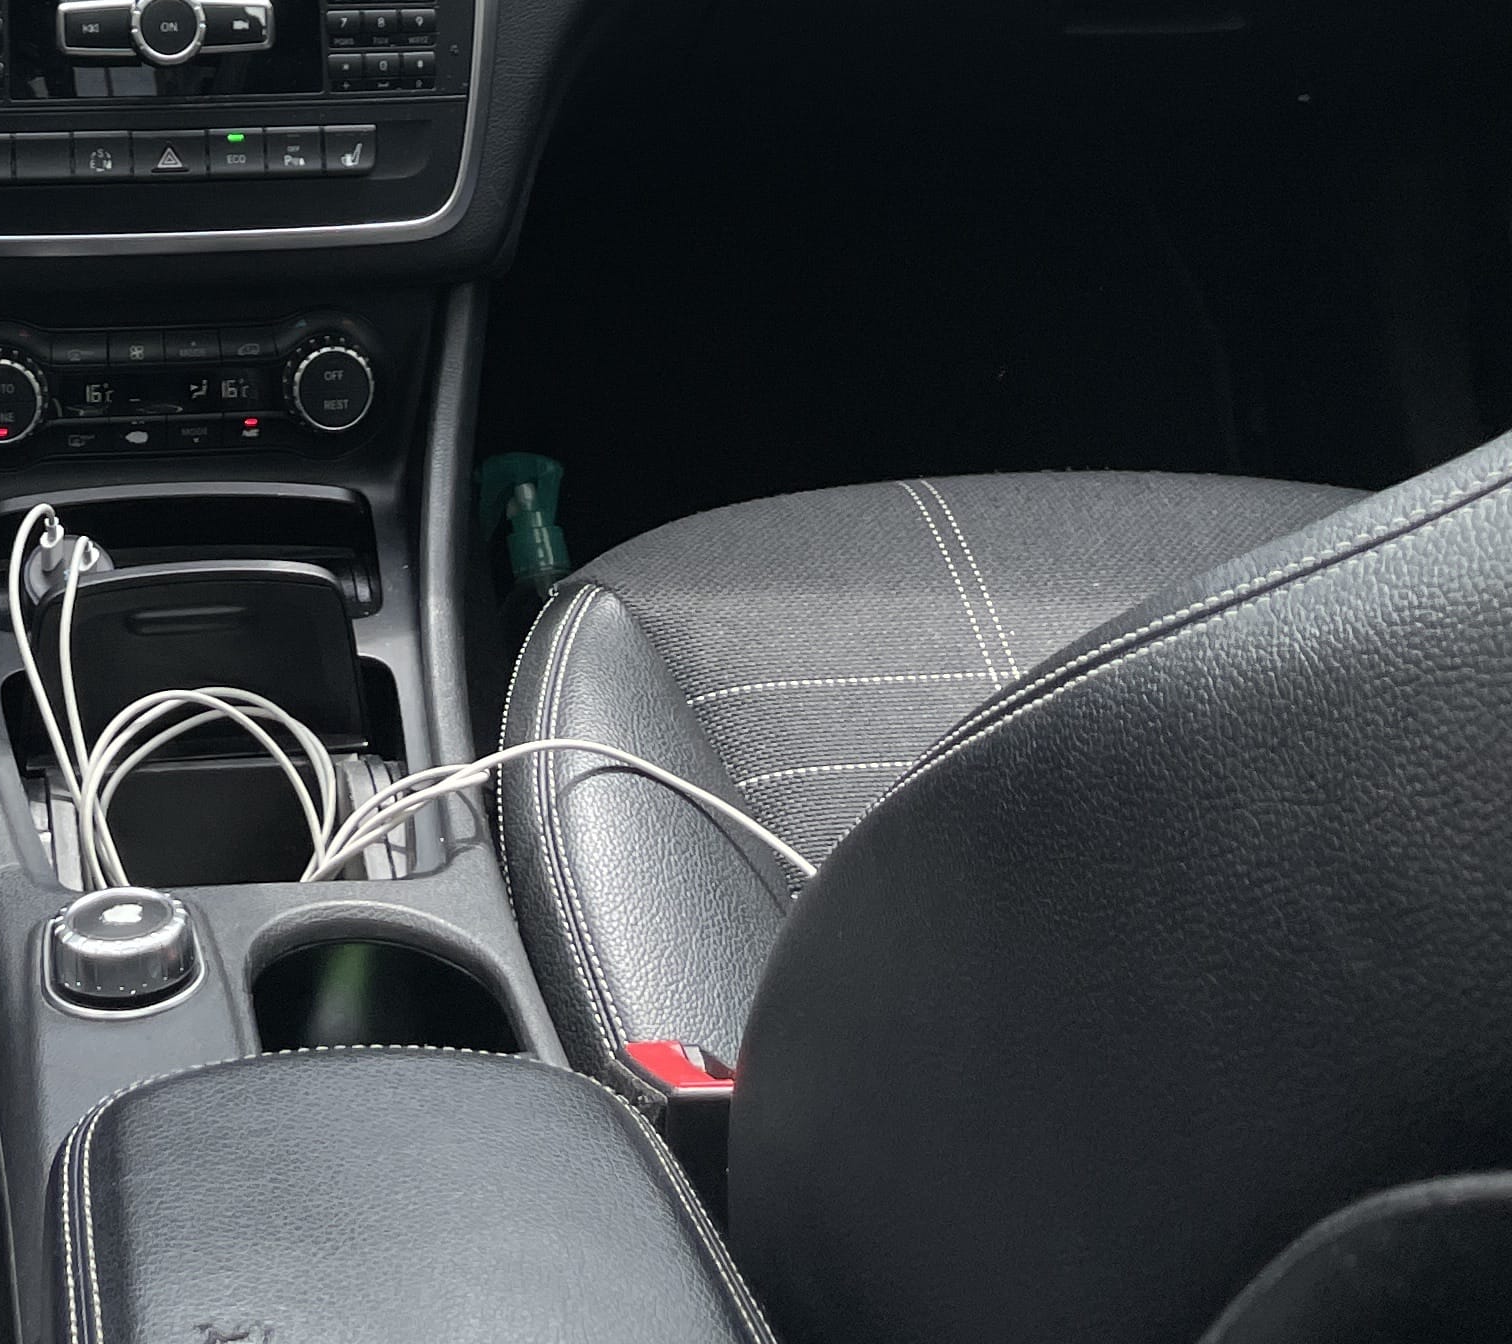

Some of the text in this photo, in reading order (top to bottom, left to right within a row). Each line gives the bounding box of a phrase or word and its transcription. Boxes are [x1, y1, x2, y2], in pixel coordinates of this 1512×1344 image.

[159, 21, 179, 33] ON
[340, 16, 348, 28] 7
[377, 16, 386, 28] 8
[415, 15, 424, 27] 9
[379, 59, 388, 71] 0
[226, 154, 247, 164] ECO
[324, 370, 345, 381] OFF
[323, 398, 349, 411] REST
